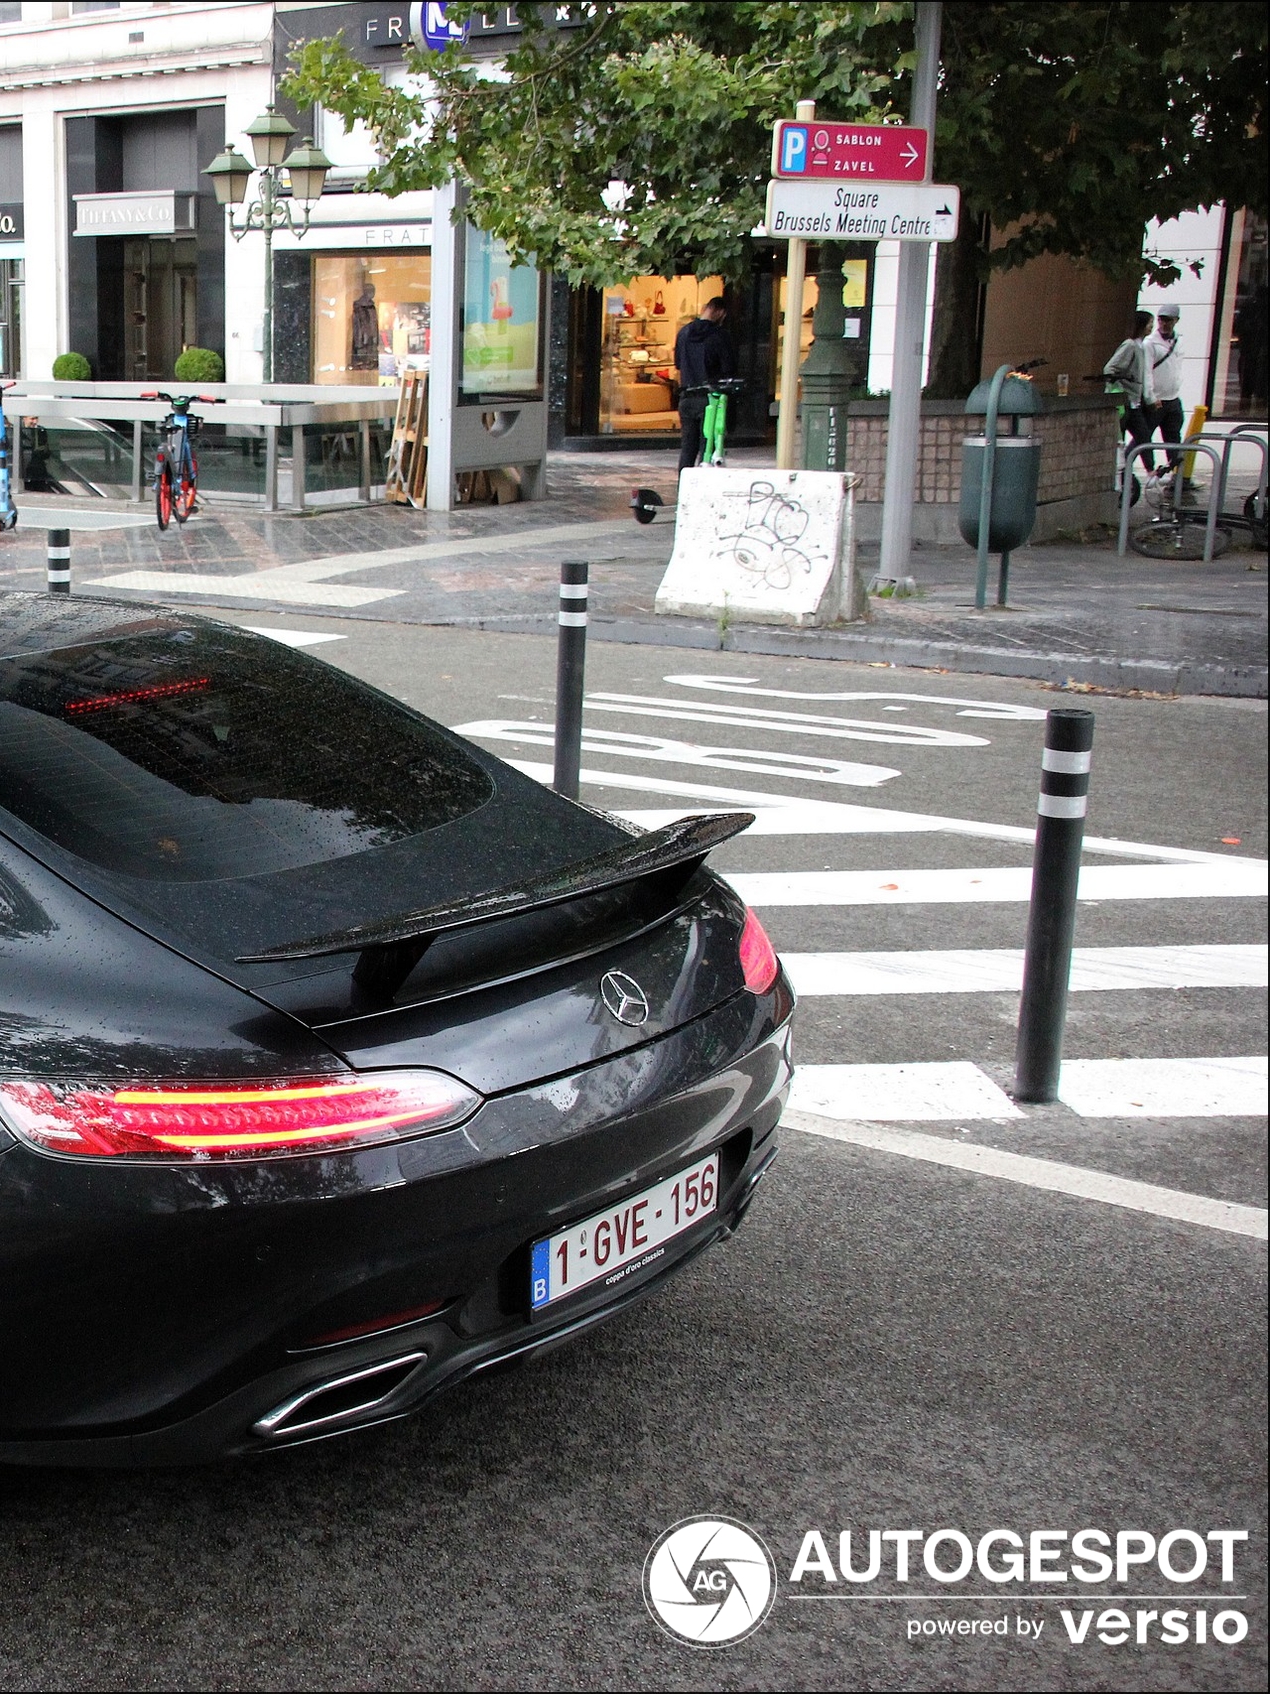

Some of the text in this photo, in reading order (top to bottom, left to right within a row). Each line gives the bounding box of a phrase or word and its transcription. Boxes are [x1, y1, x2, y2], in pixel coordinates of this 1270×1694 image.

[785, 131, 805, 169] P
[836, 135, 882, 146] SABLON
[834, 160, 875, 172] ZAVEL
[834, 188, 879, 212] Square
[774, 211, 831, 232] Brussels
[836, 214, 887, 238] Meeting
[891, 215, 930, 235] Centre
[556, 1163, 715, 1286] 1-GVE-156
[605, 1247, 665, 1285] coppa d'oro classics
[534, 1278, 547, 1302] B
